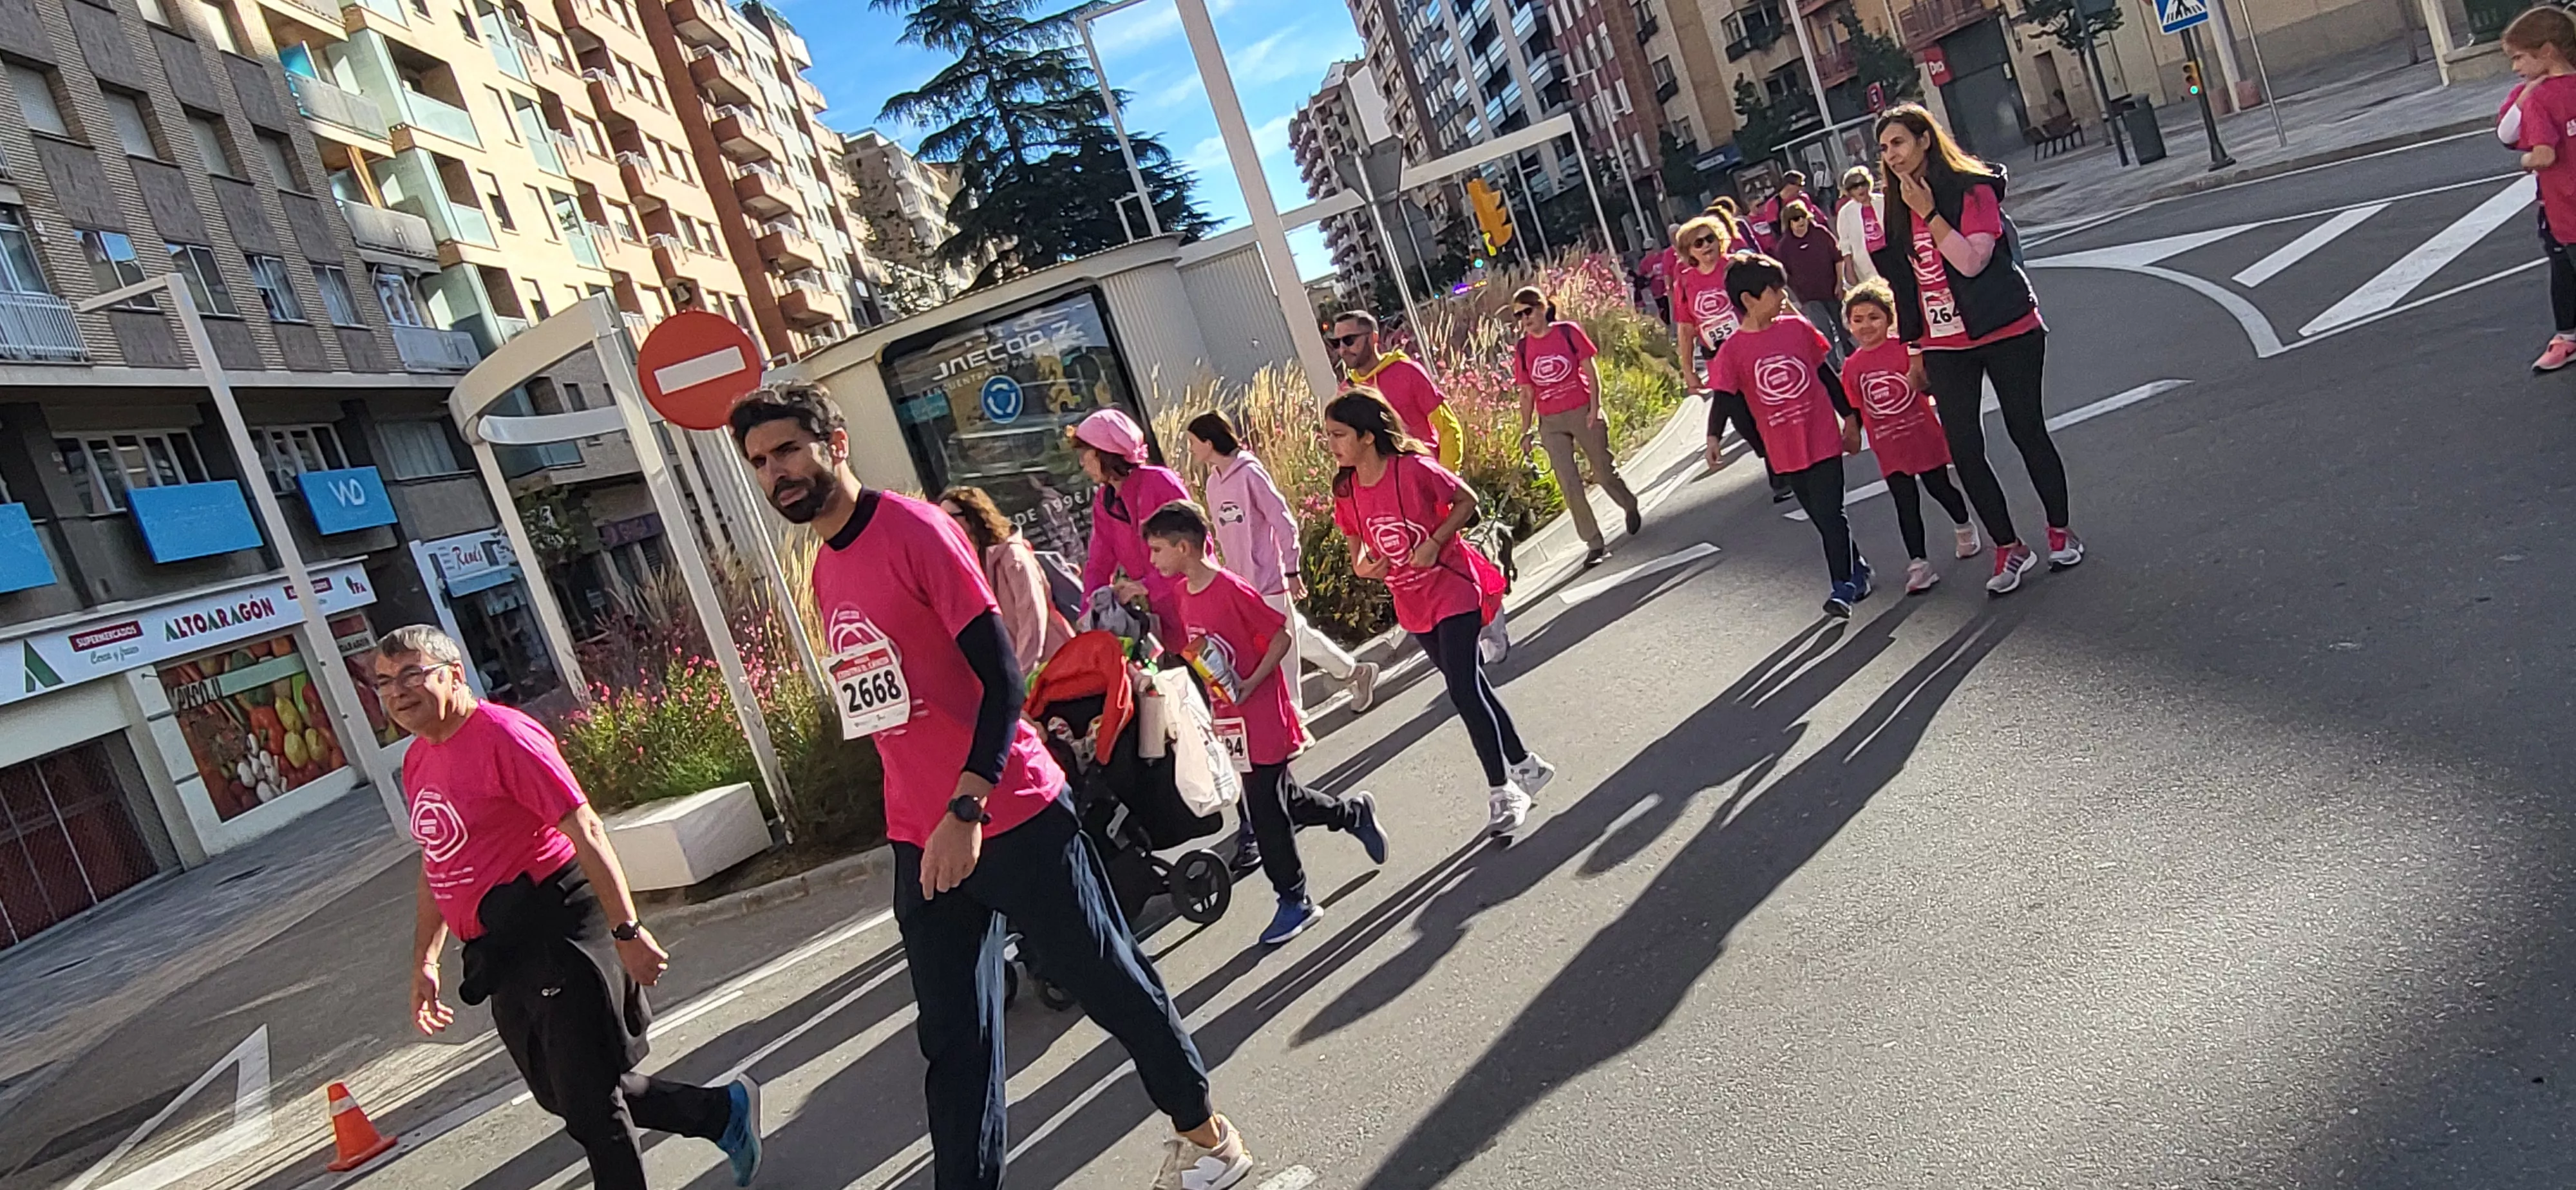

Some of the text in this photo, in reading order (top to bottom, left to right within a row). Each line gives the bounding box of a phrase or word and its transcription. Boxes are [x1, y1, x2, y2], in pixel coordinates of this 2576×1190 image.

[1709, 323, 1732, 341] 955
[164, 594, 276, 643] ALTOARAGÓN
[842, 669, 902, 713] 2668
[1226, 737, 1244, 757] 94
